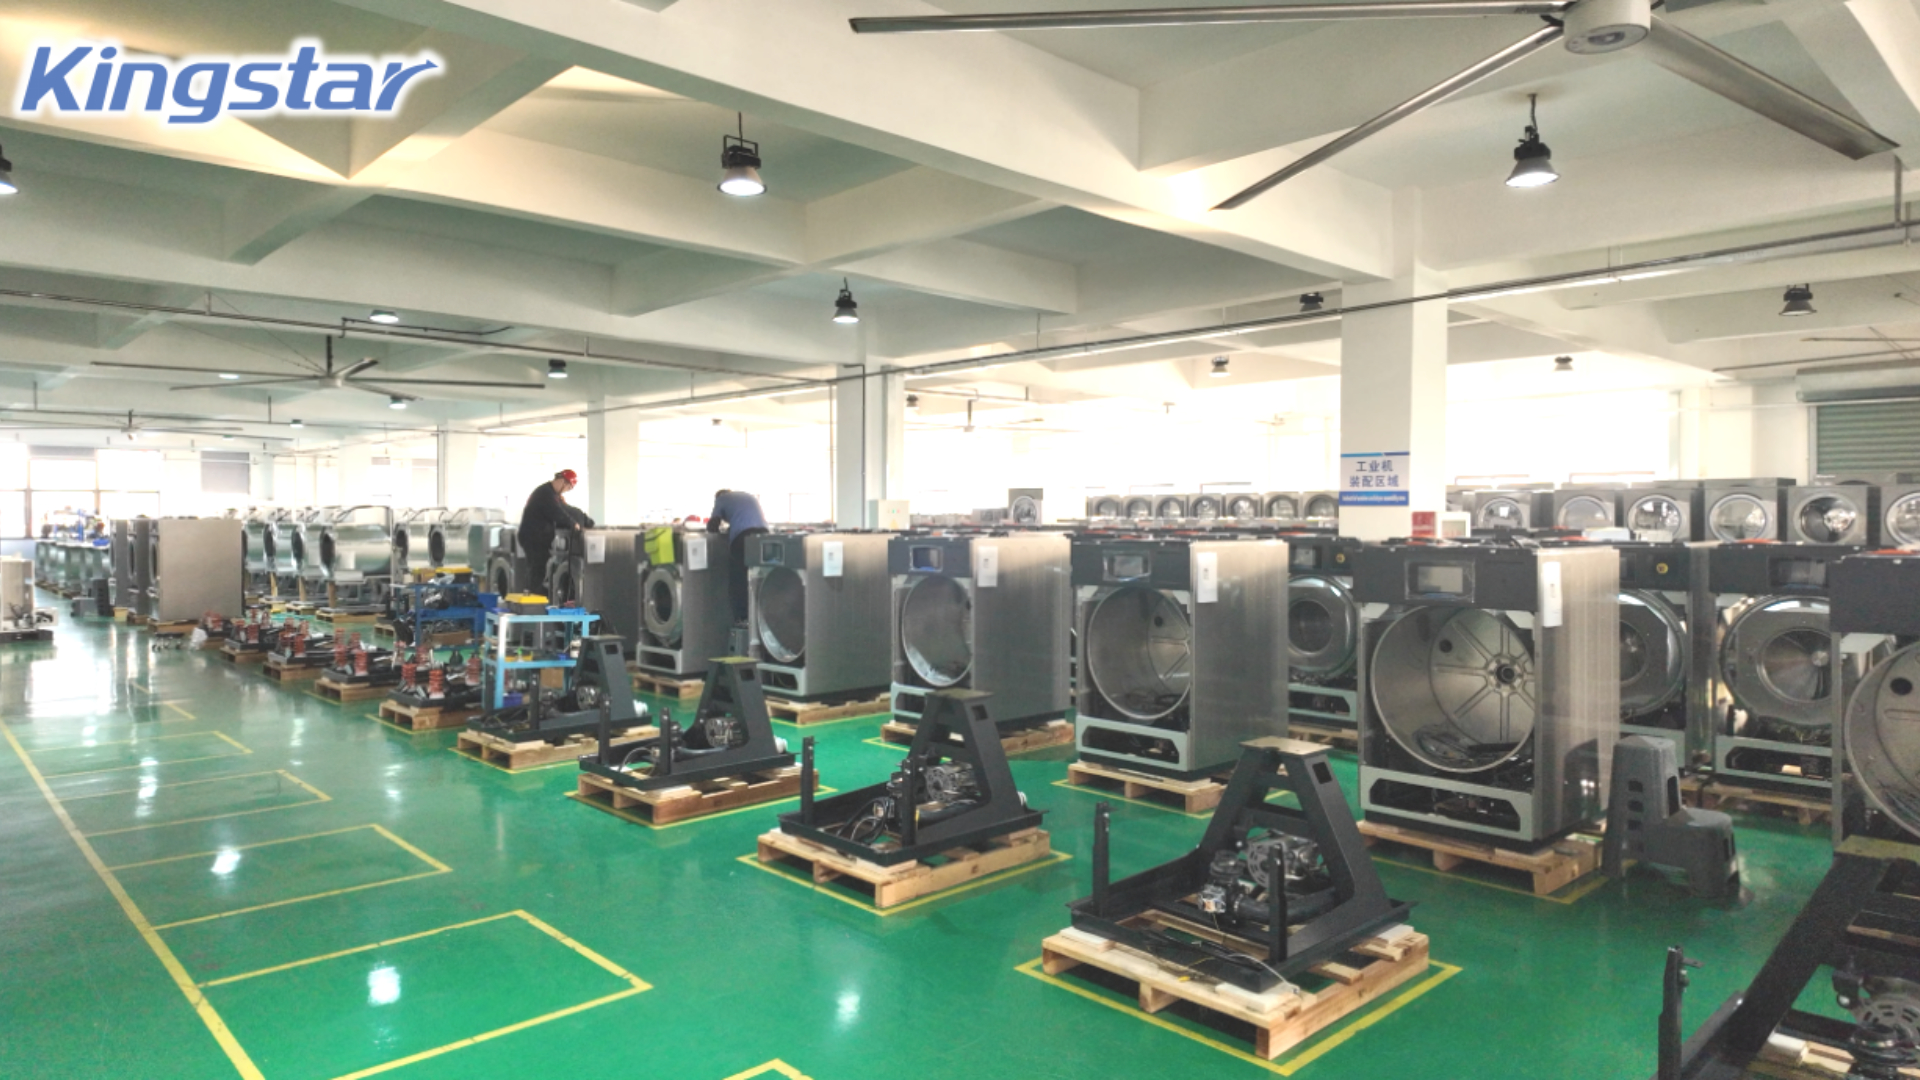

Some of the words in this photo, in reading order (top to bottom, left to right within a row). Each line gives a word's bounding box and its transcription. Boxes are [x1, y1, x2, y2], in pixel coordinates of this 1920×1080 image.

[1356, 460, 1393, 473] 工业机
[1349, 475, 1399, 488] 装配区域
